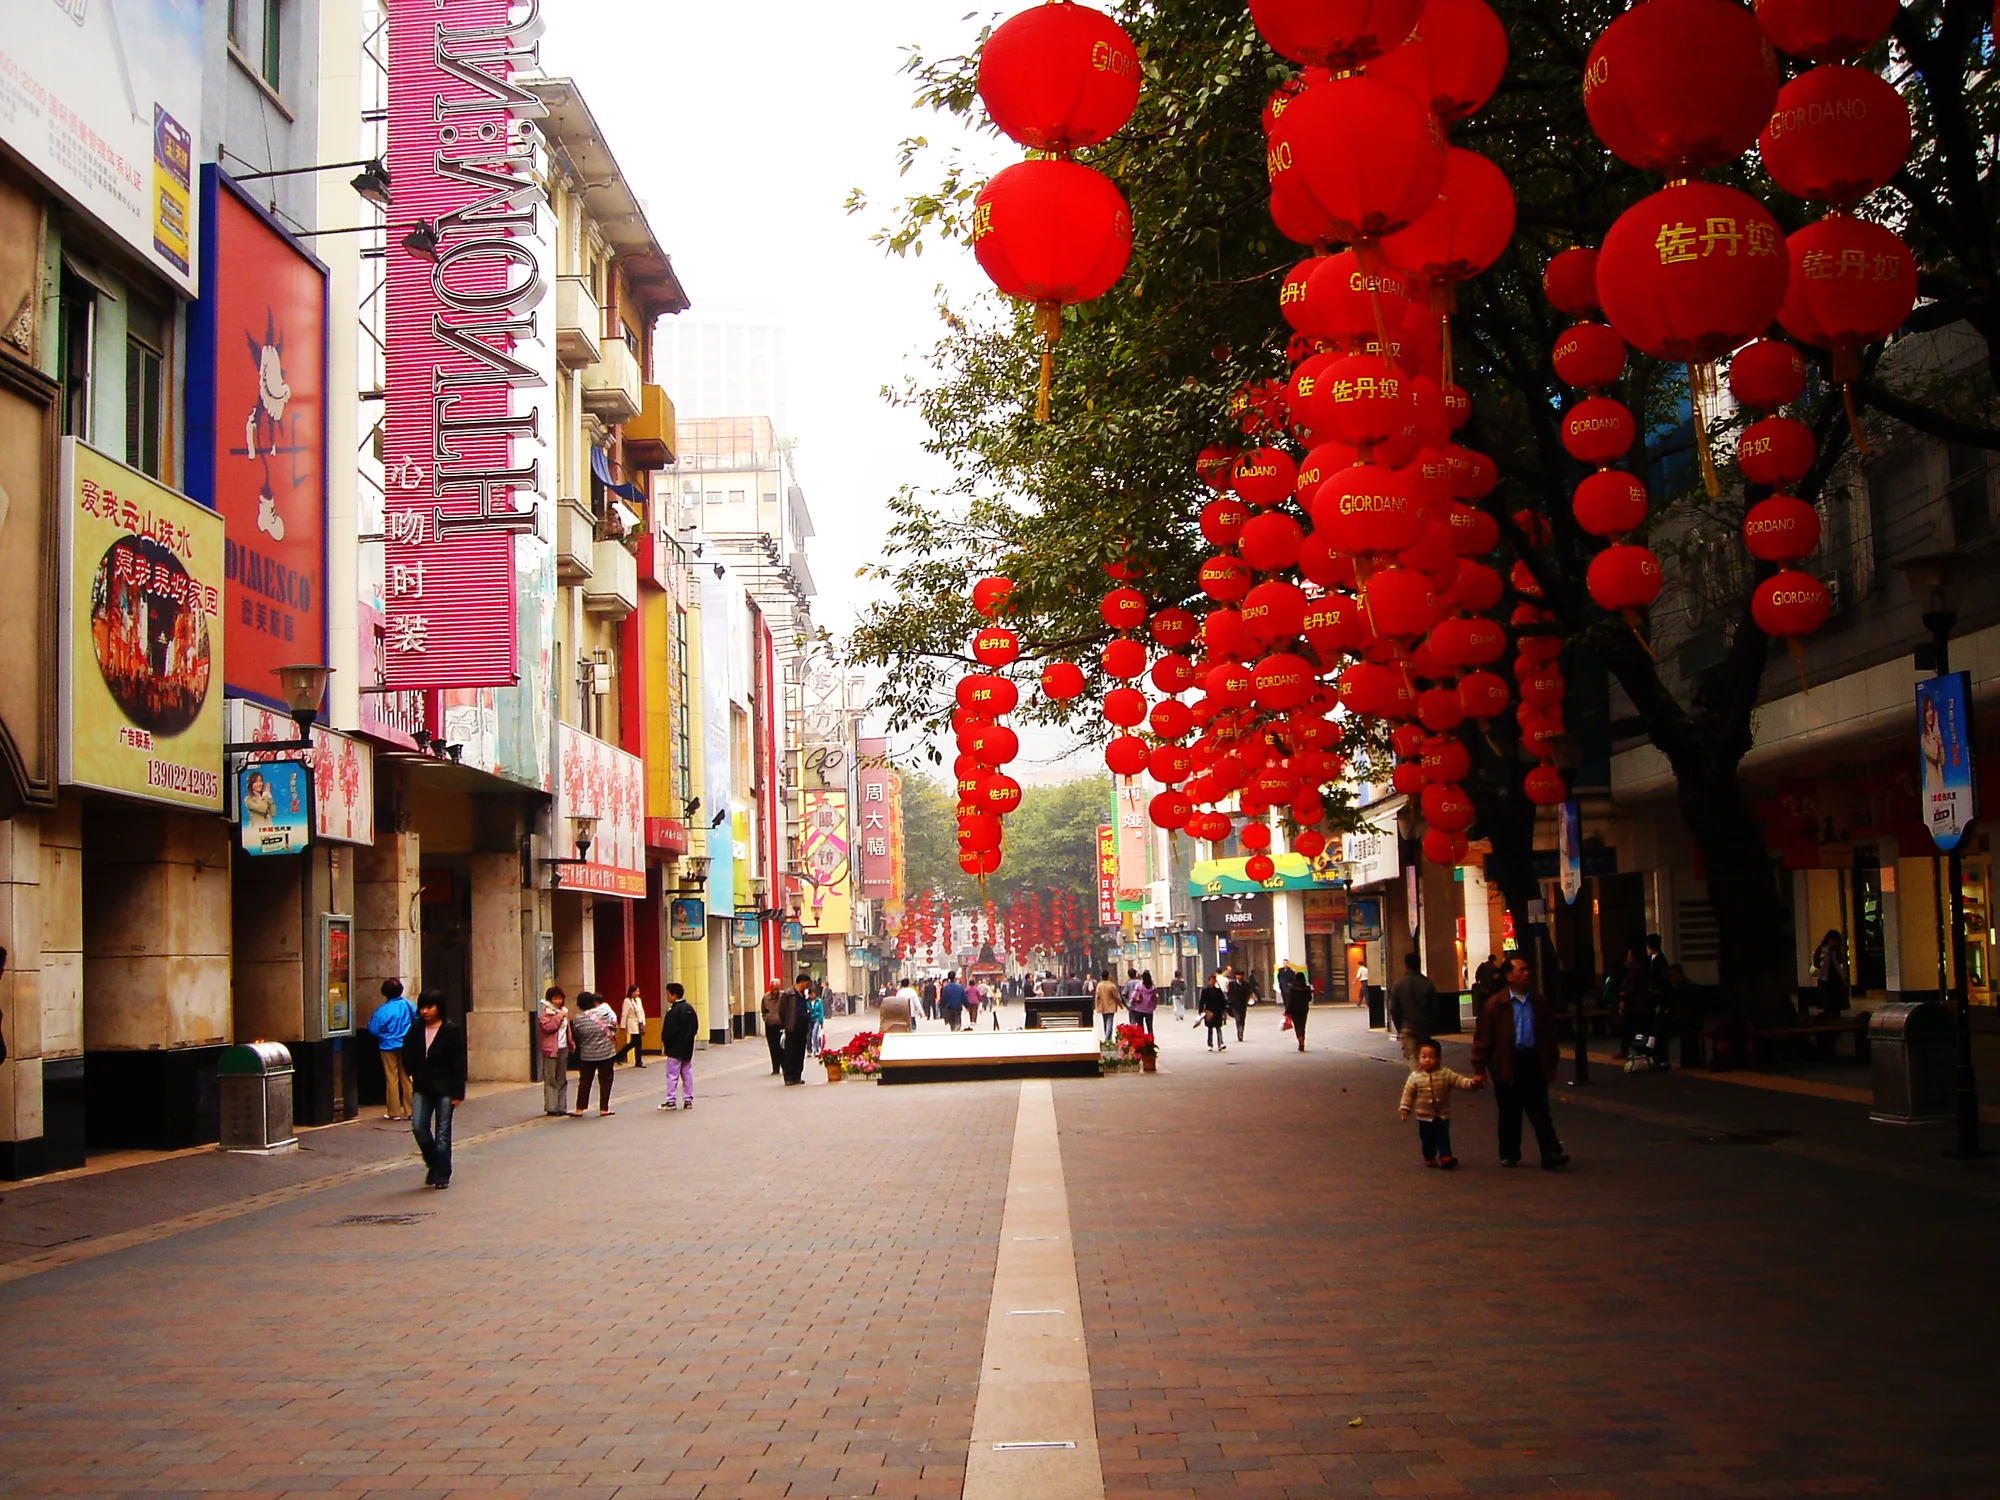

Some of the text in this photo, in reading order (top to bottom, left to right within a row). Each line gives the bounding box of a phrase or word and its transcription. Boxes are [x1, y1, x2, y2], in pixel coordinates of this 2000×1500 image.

[1768, 98, 1867, 140] GIORDANO
[1655, 217, 1779, 265] 佐丹奴
[1802, 249, 1901, 284] 佐丹奴
[1332, 377, 1400, 403] 佐丹奴
[1571, 417, 1620, 436] GIORDANO
[81, 479, 192, 559] 爱我云山珠水
[1340, 494, 1408, 515] GIORDANO
[1746, 517, 1796, 535] GIORDANO
[391, 455, 429, 652] 心吻时装
[225, 536, 310, 614] DIMESCO
[1773, 590, 1825, 607] GIORDANO
[1154, 620, 1183, 632] 佐丹奴
[979, 638, 1011, 650] 佐丹奴
[1256, 674, 1300, 690] GIORDANO
[147, 760, 218, 798] 13902242935
[865, 782, 886, 857] 周大福
